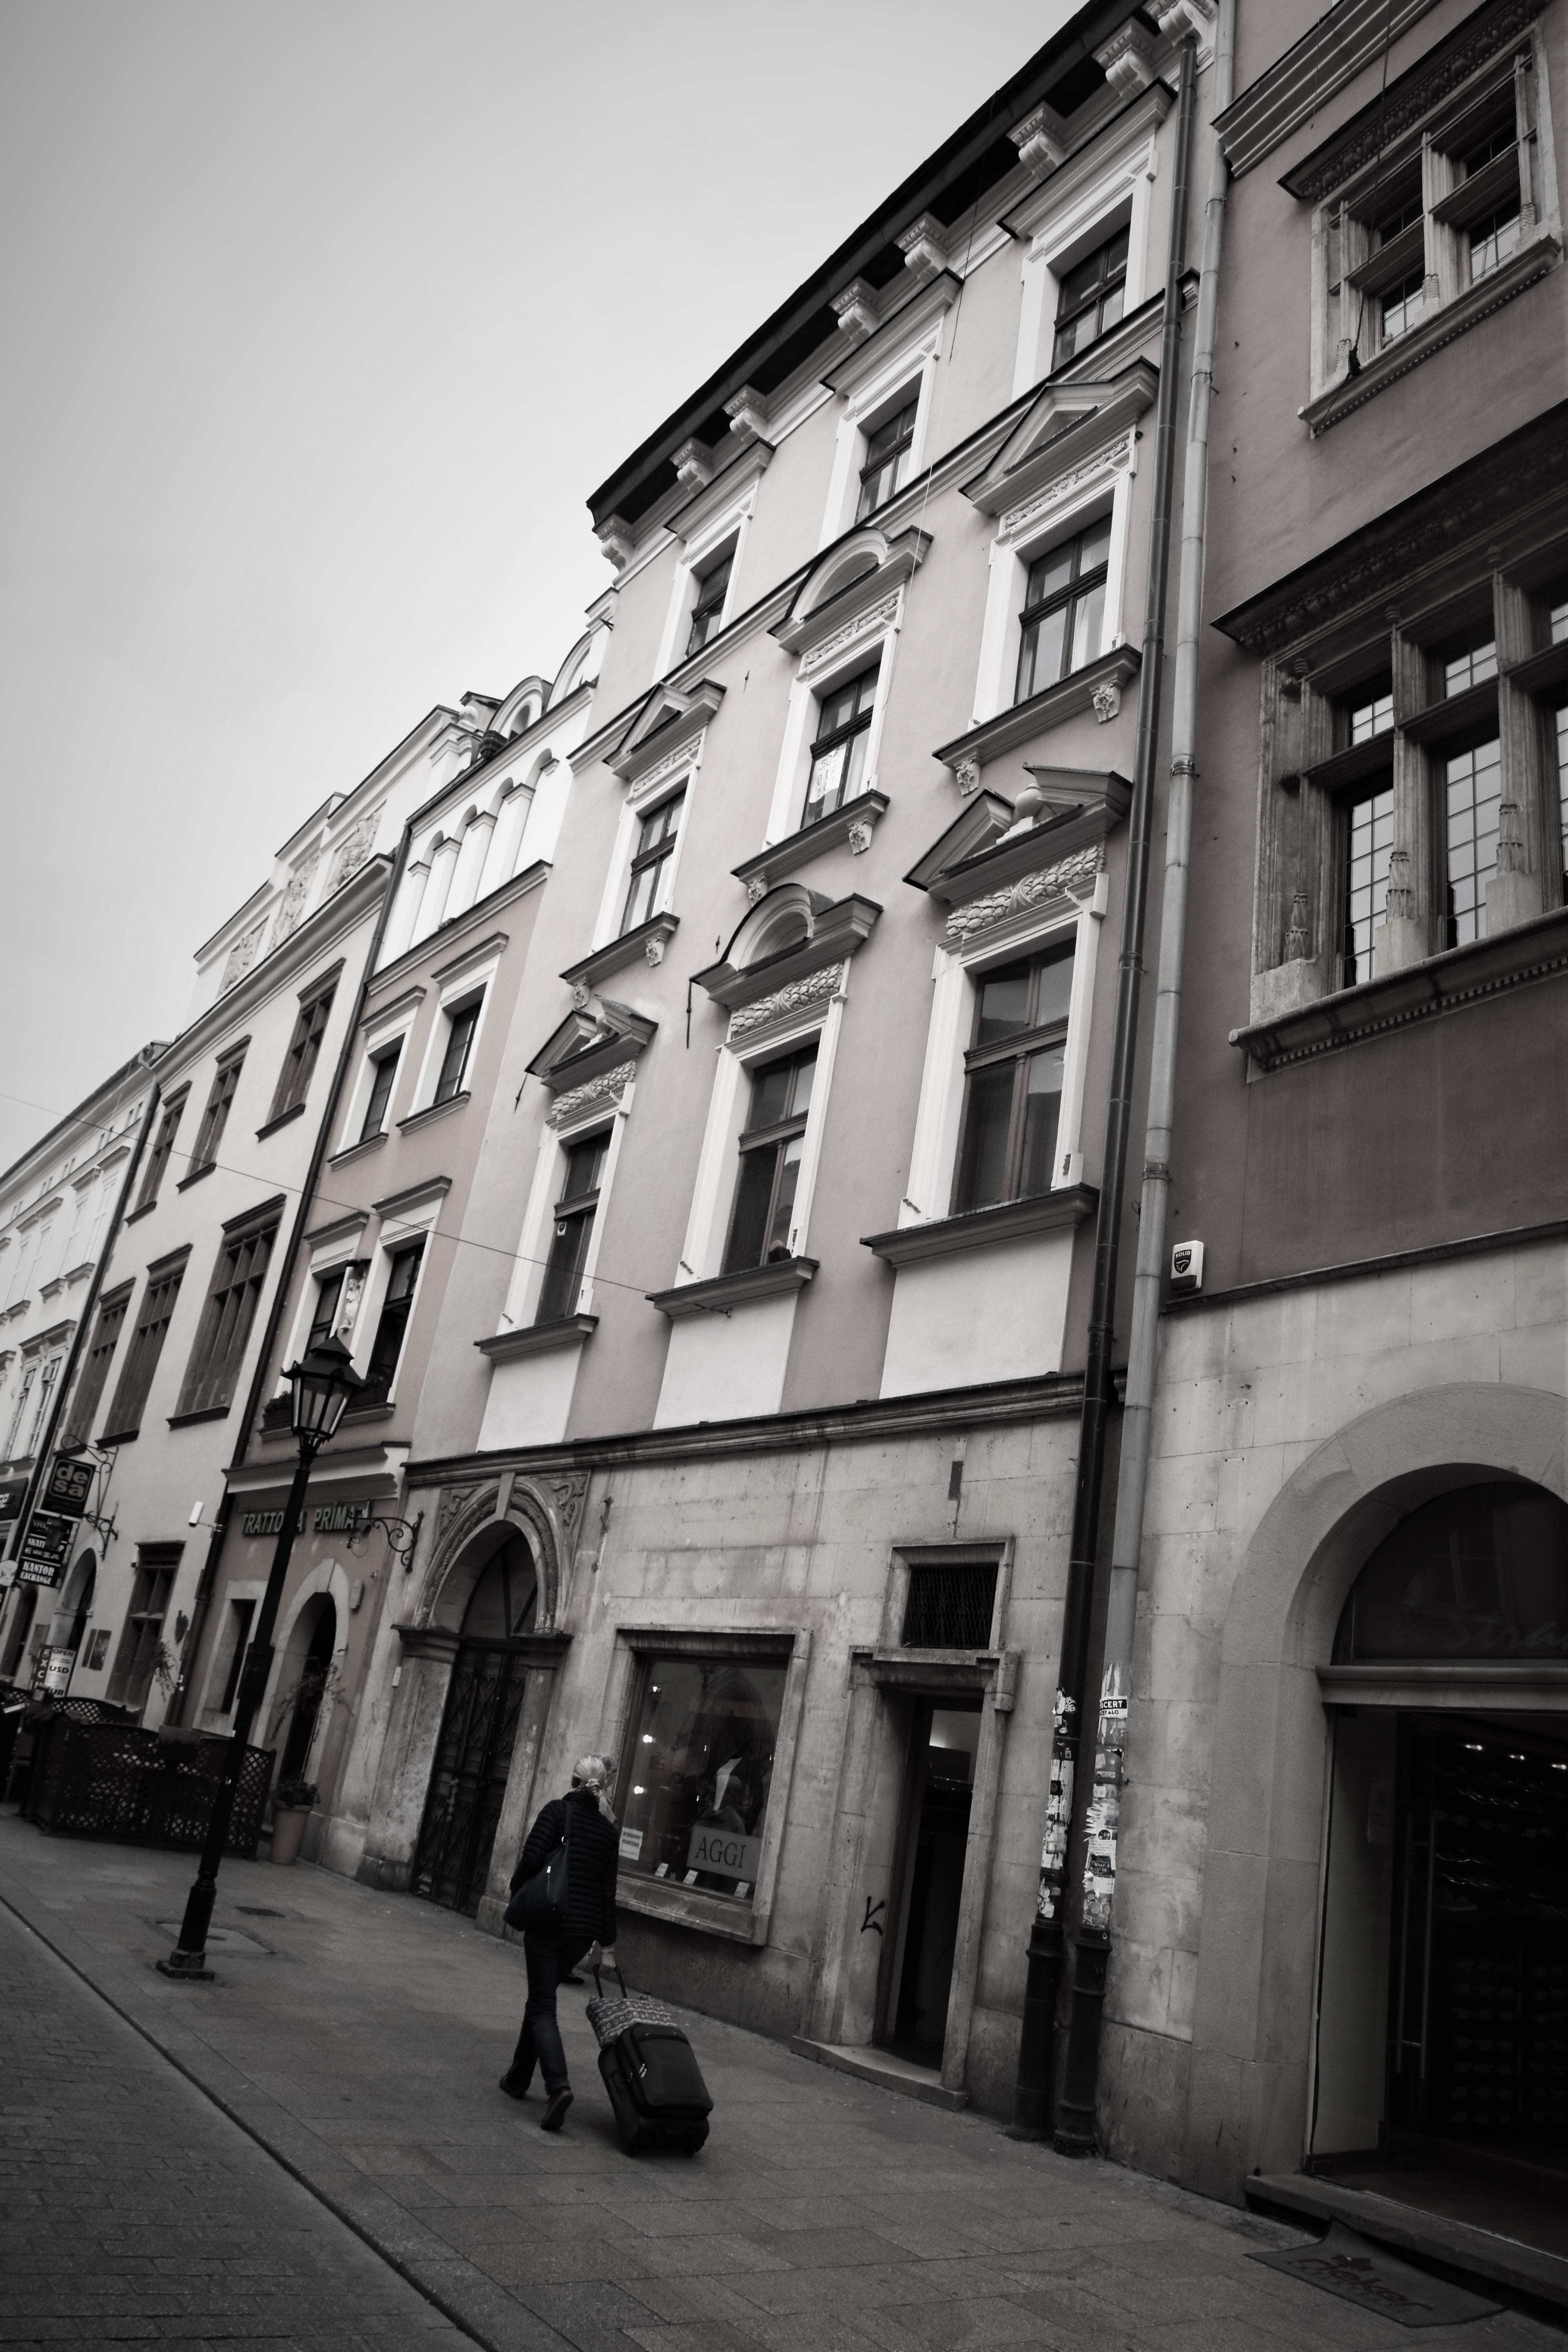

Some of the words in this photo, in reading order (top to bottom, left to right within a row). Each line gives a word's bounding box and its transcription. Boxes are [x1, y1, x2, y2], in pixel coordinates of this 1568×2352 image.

[1175, 1250, 1191, 1258] SOLID
[56, 1465, 89, 1484] de
[53, 1479, 85, 1497] sa
[242, 1510, 305, 1534] TRATTOA
[314, 1506, 355, 1530] PRIMA
[22, 1561, 55, 1577] KANTOR
[20, 1571, 52, 1585] EXCHANGE
[53, 1648, 74, 1657] OPEN
[49, 1665, 69, 1673] USD
[49, 1687, 64, 1696] UR
[695, 1836, 746, 1869] AGGI
